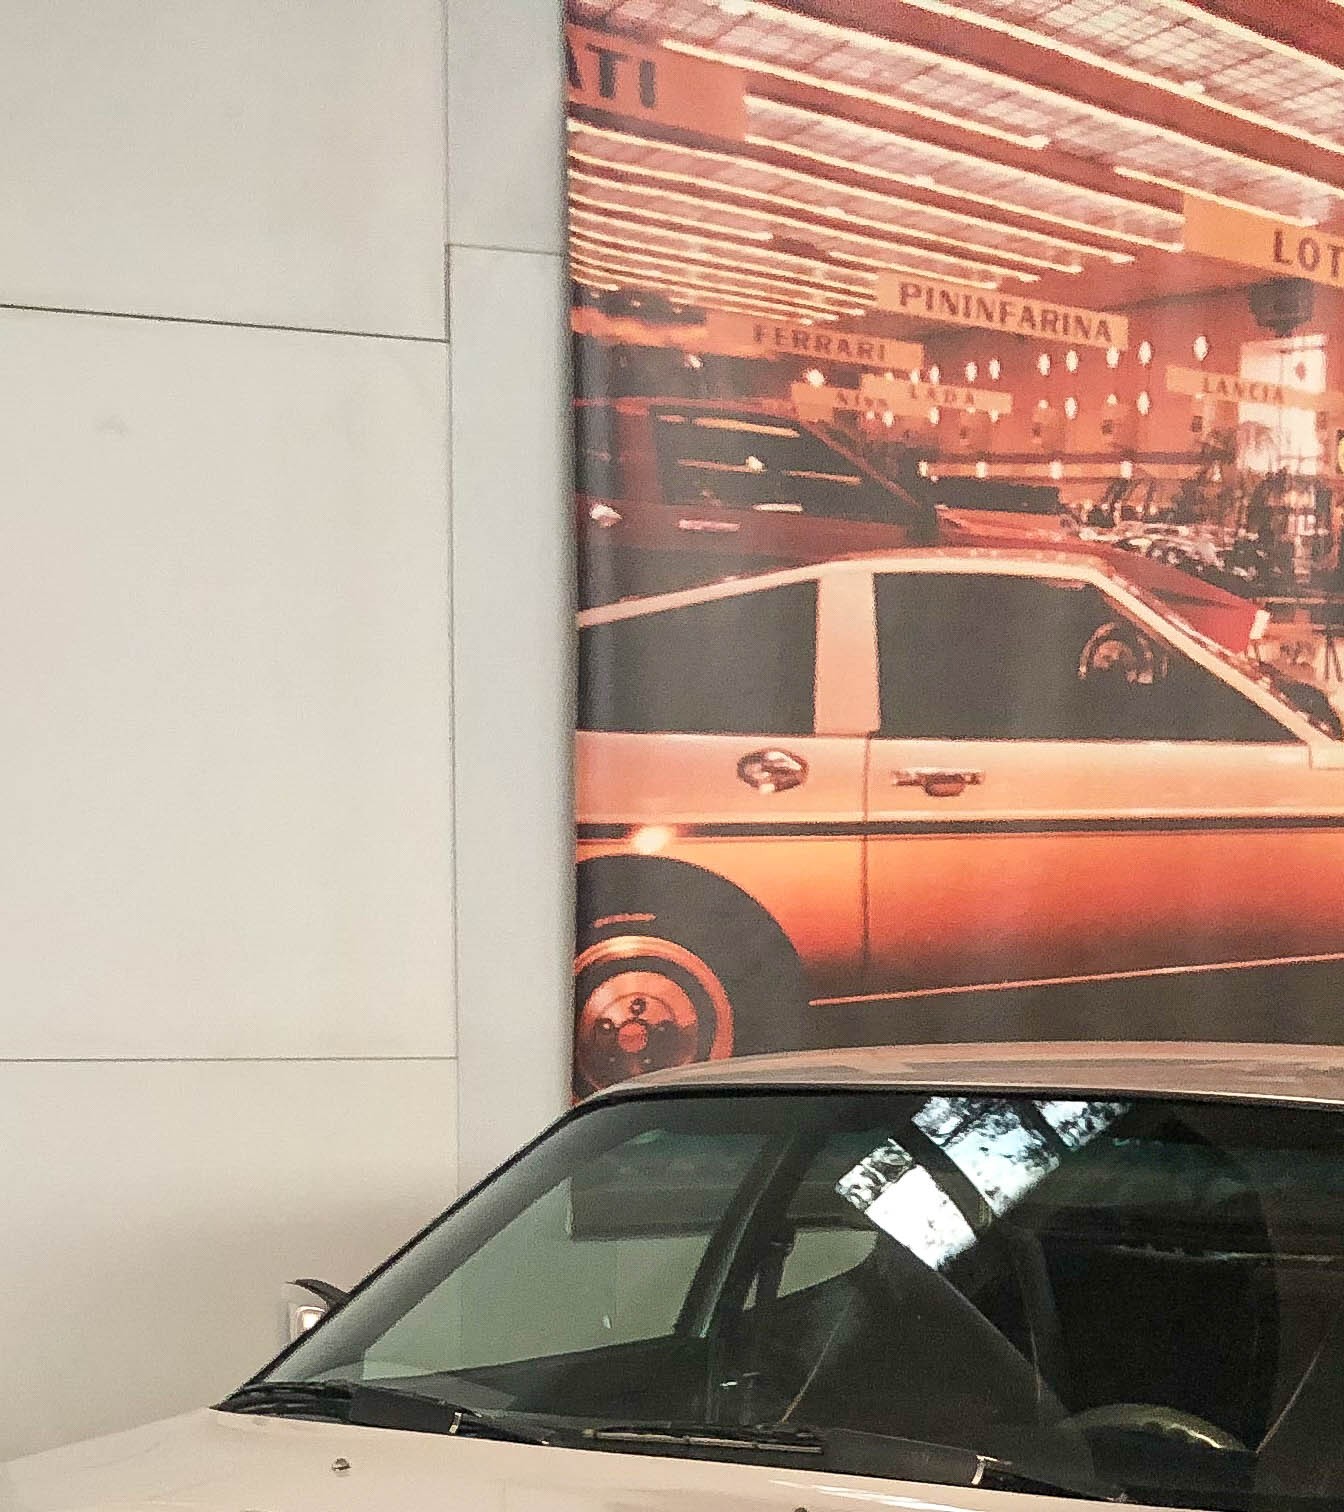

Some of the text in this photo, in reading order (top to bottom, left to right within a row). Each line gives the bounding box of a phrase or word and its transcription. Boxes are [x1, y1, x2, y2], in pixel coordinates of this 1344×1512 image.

[898, 280, 1113, 344] PININFARINA
[752, 321, 887, 362] FERRARI
[1202, 376, 1285, 402] LANCIA
